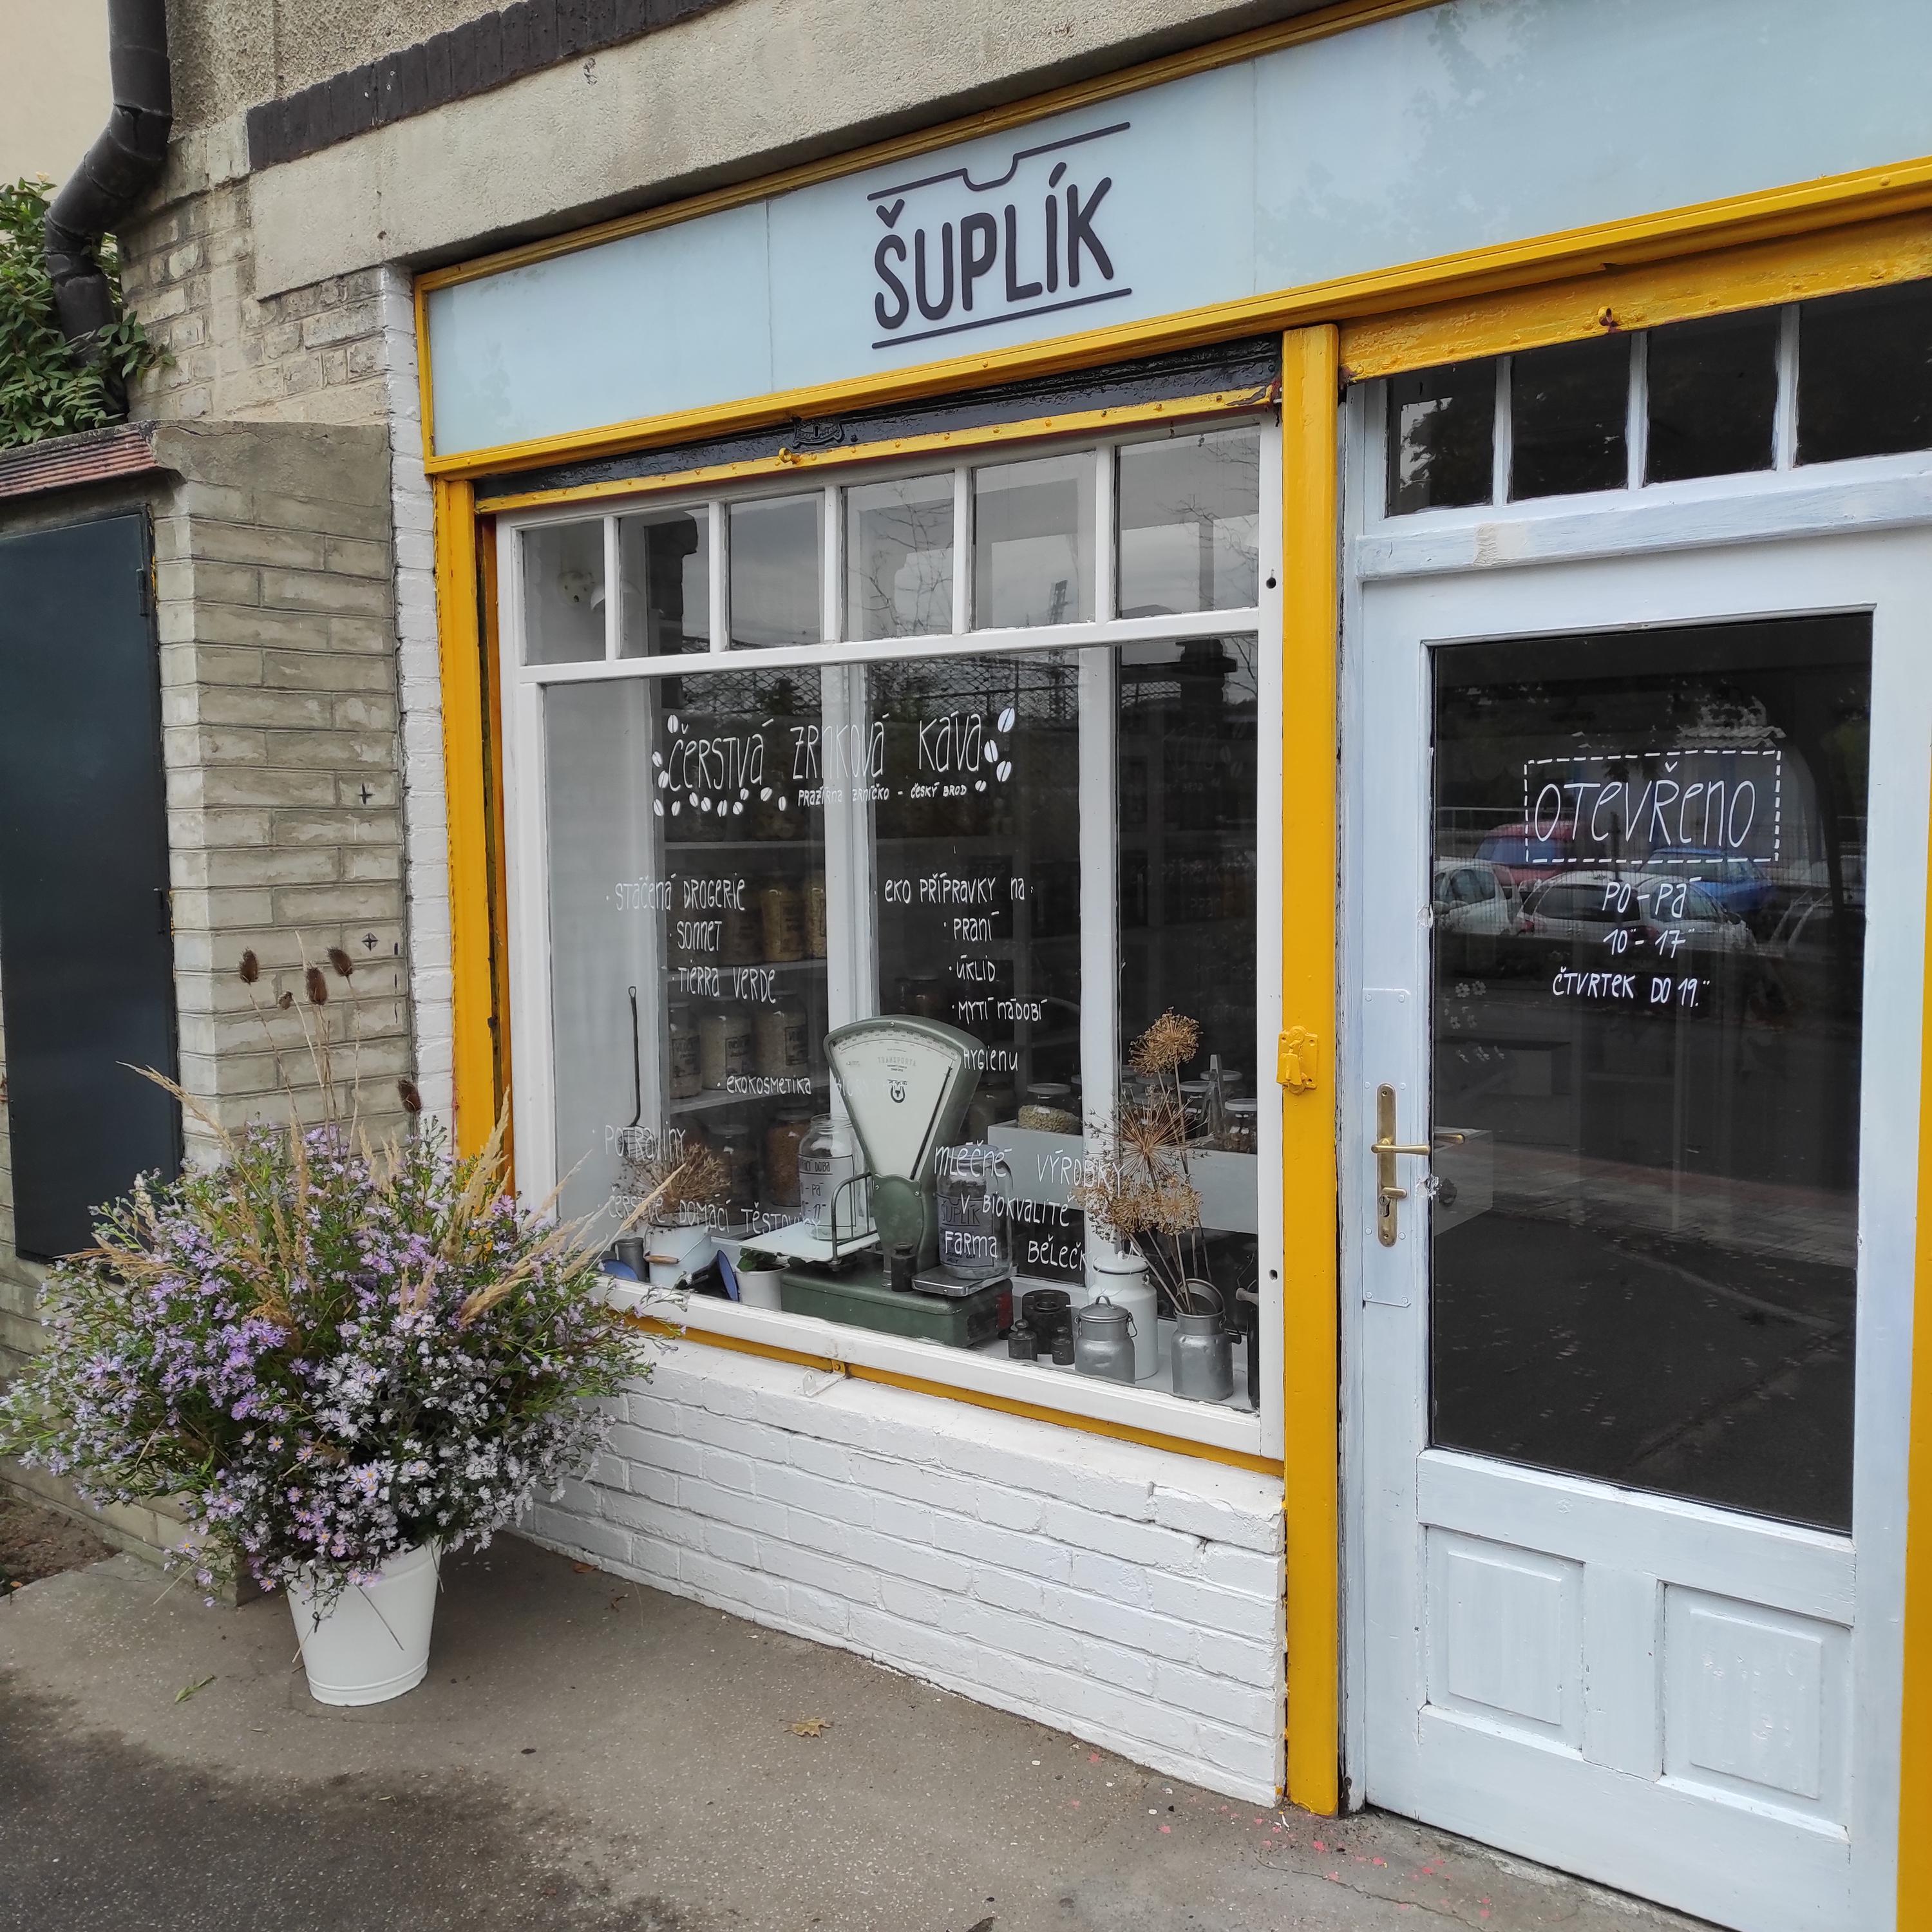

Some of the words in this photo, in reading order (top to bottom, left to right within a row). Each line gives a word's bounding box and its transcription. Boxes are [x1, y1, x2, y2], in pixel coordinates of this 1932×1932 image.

[875, 162, 1114, 330] ŠUPLÍK
[943, 784, 967, 797] BROD
[1651, 978, 1671, 1004] DO
